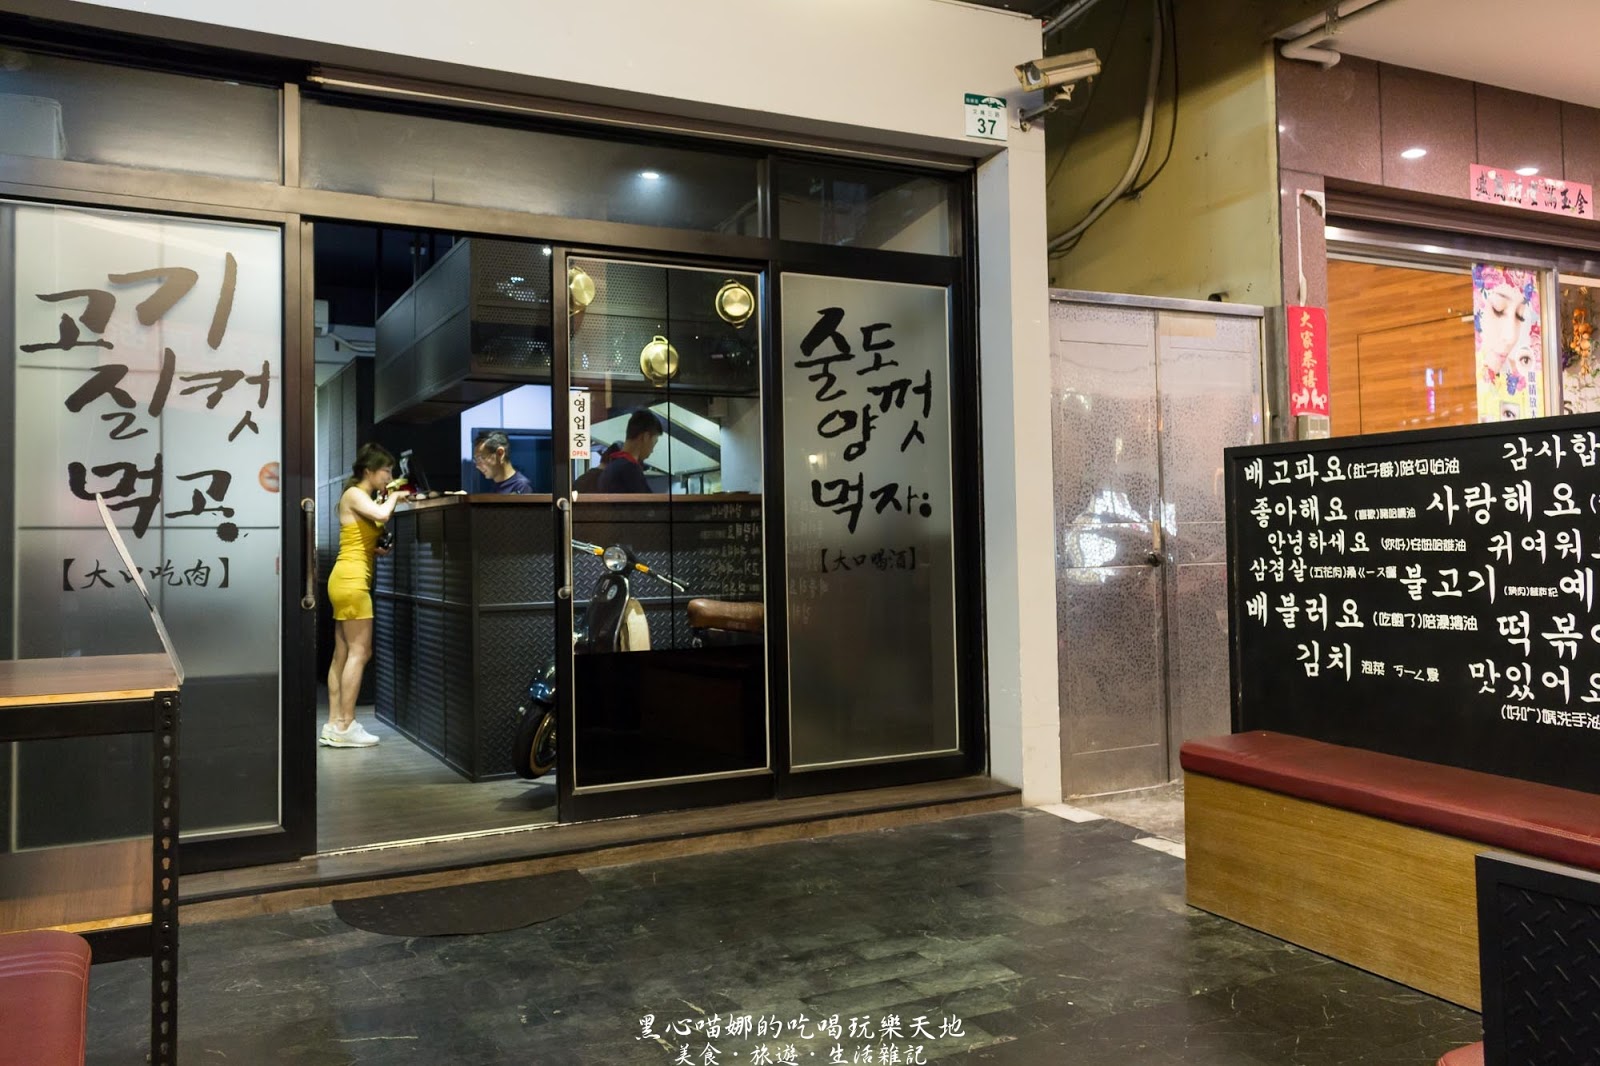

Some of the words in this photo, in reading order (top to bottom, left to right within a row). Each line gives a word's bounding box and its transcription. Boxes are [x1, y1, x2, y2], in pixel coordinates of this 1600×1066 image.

[977, 117, 997, 135] 37
[20, 251, 238, 352] 고기
[573, 398, 587, 448] 영업중
[1244, 454, 1346, 489] 배고파요
[1250, 495, 1347, 531] 좋아해요
[1426, 480, 1581, 525] 사랑해요
[1265, 527, 1370, 555] 안녕하세요
[1485, 528, 1600, 567] 귀여워
[1250, 557, 1307, 582] 삼겹살
[1400, 564, 1495, 604] 불고기
[1557, 567, 1593, 614] 예
[1246, 591, 1364, 631] 배불러요
[1497, 608, 1600, 660] 떡볶
[1297, 640, 1351, 681] 김치
[1362, 660, 1385, 675] 泡菜
